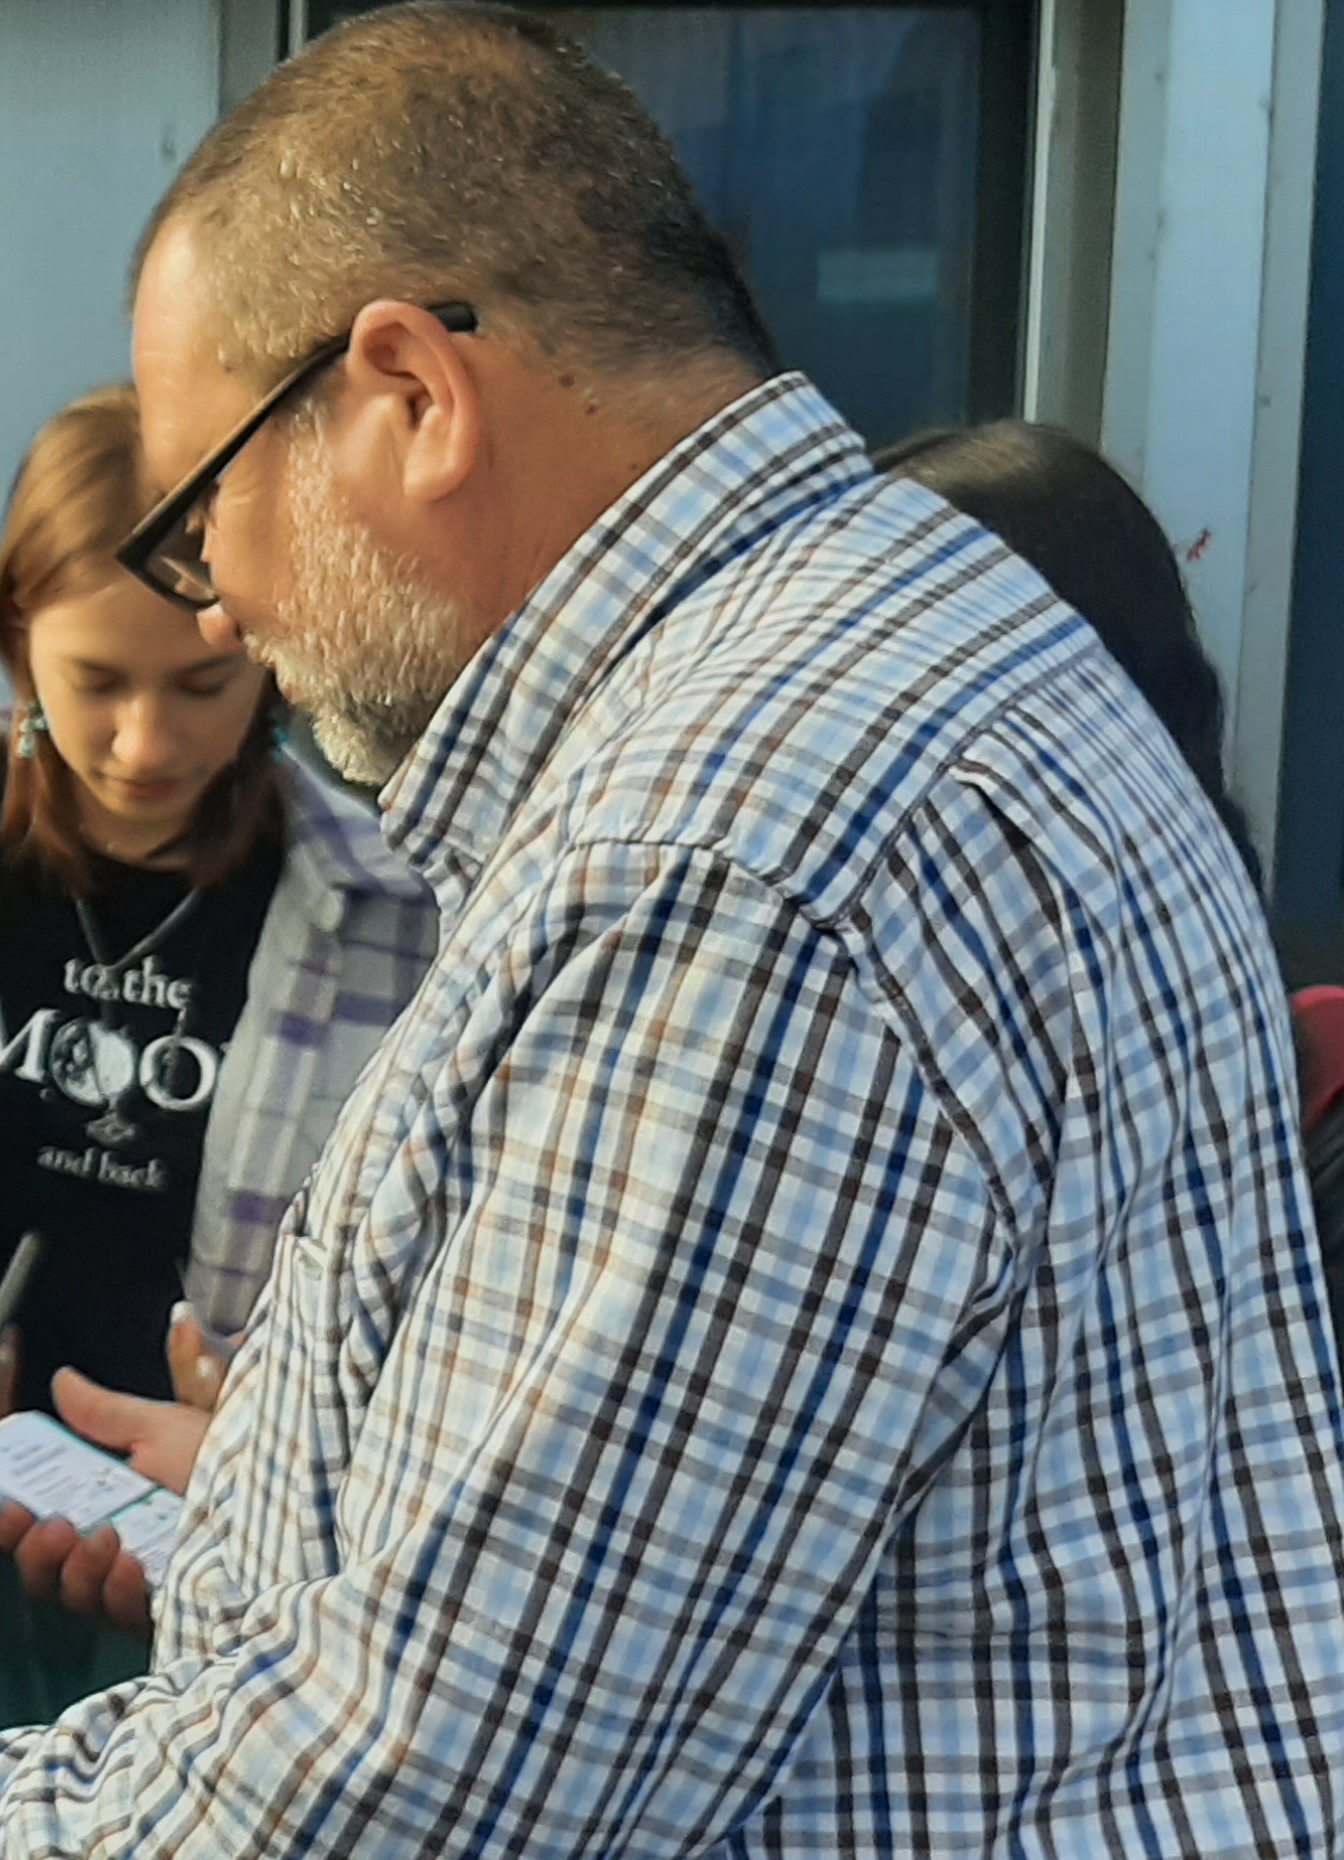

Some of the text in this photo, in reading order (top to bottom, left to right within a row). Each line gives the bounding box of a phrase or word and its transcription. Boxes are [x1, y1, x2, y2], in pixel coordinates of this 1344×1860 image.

[62, 954, 193, 1010] to the
[36, 1145, 165, 1192] and back
